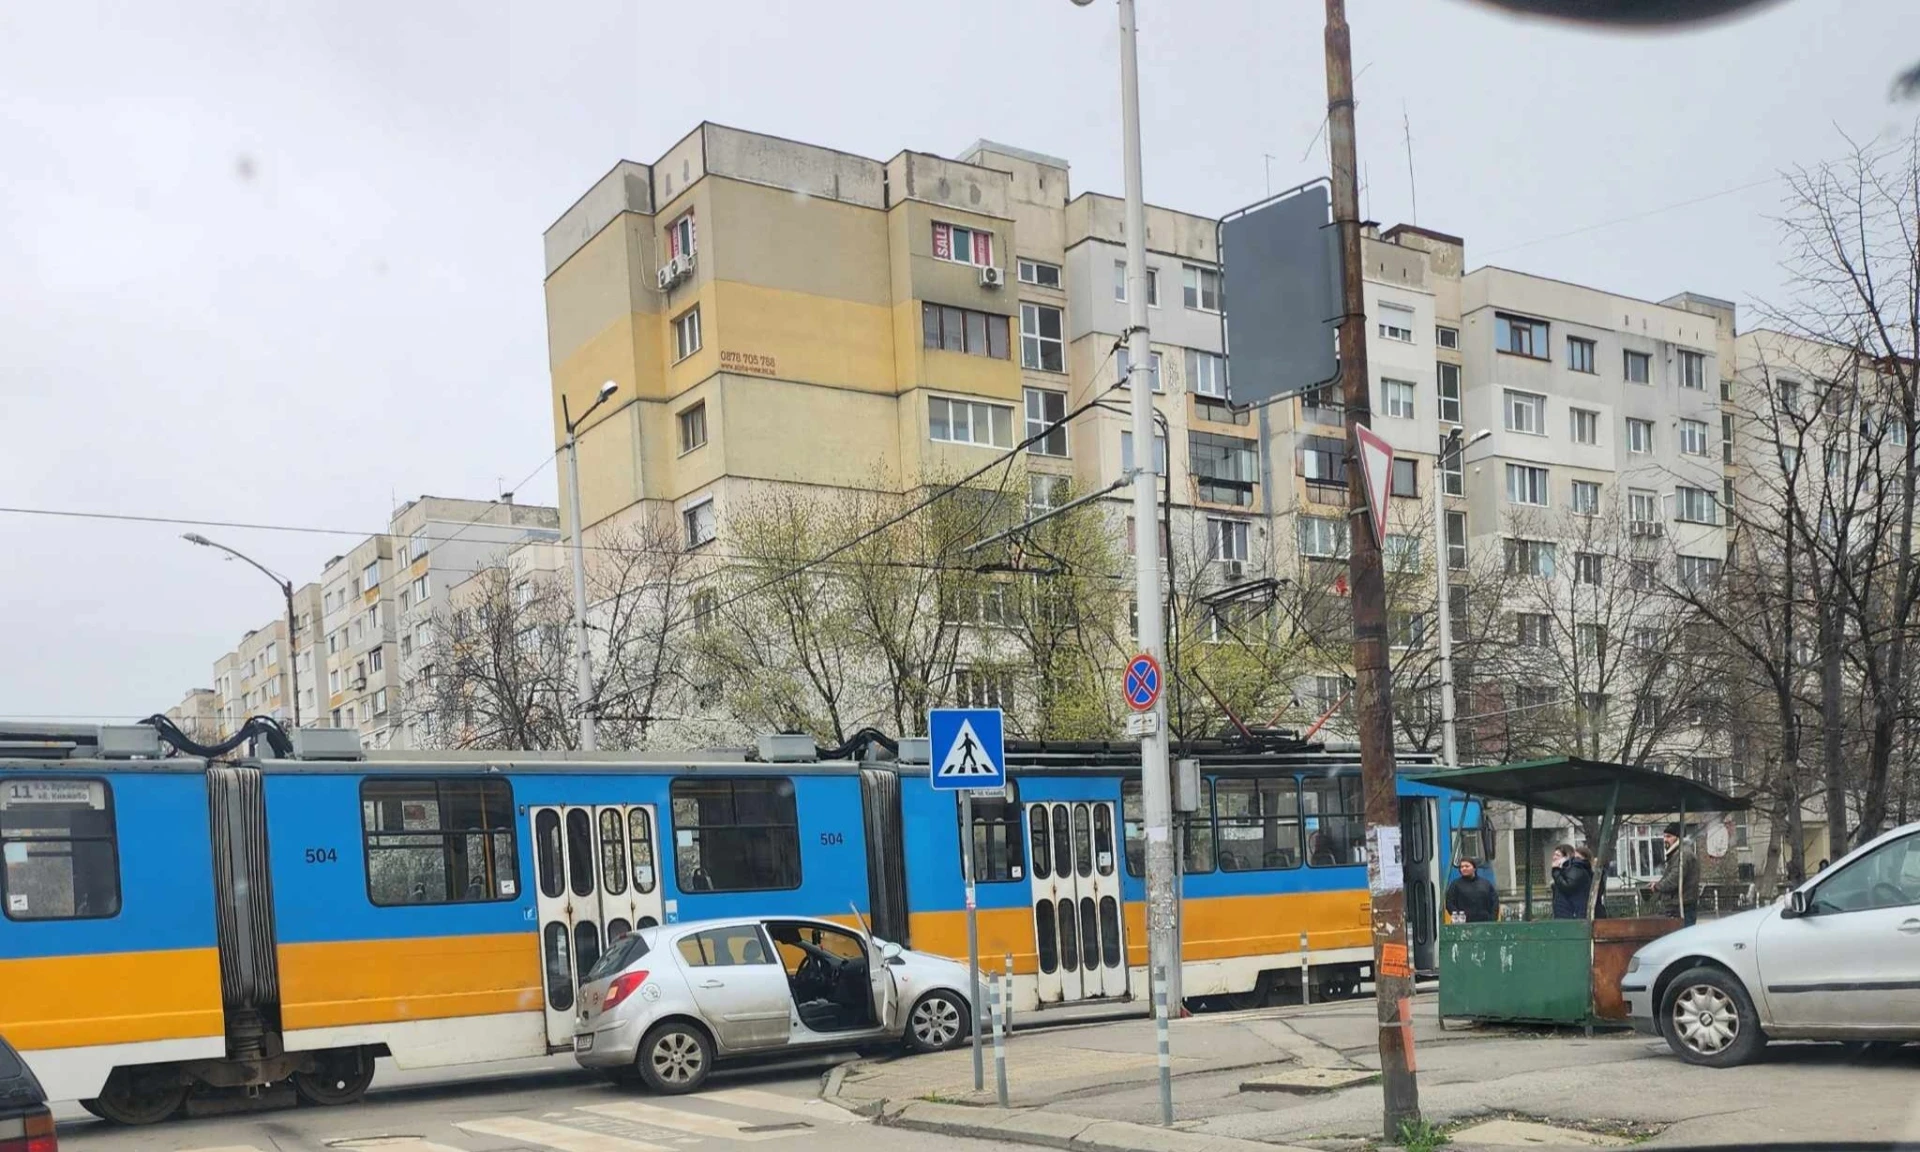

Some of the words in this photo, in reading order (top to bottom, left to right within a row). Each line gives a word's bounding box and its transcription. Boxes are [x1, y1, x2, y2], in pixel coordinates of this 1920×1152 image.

[936, 223, 949, 258] SALE
[742, 353, 759, 365] 705
[11, 785, 33, 799] 11
[820, 832, 844, 846] 504
[305, 848, 338, 864] 504
